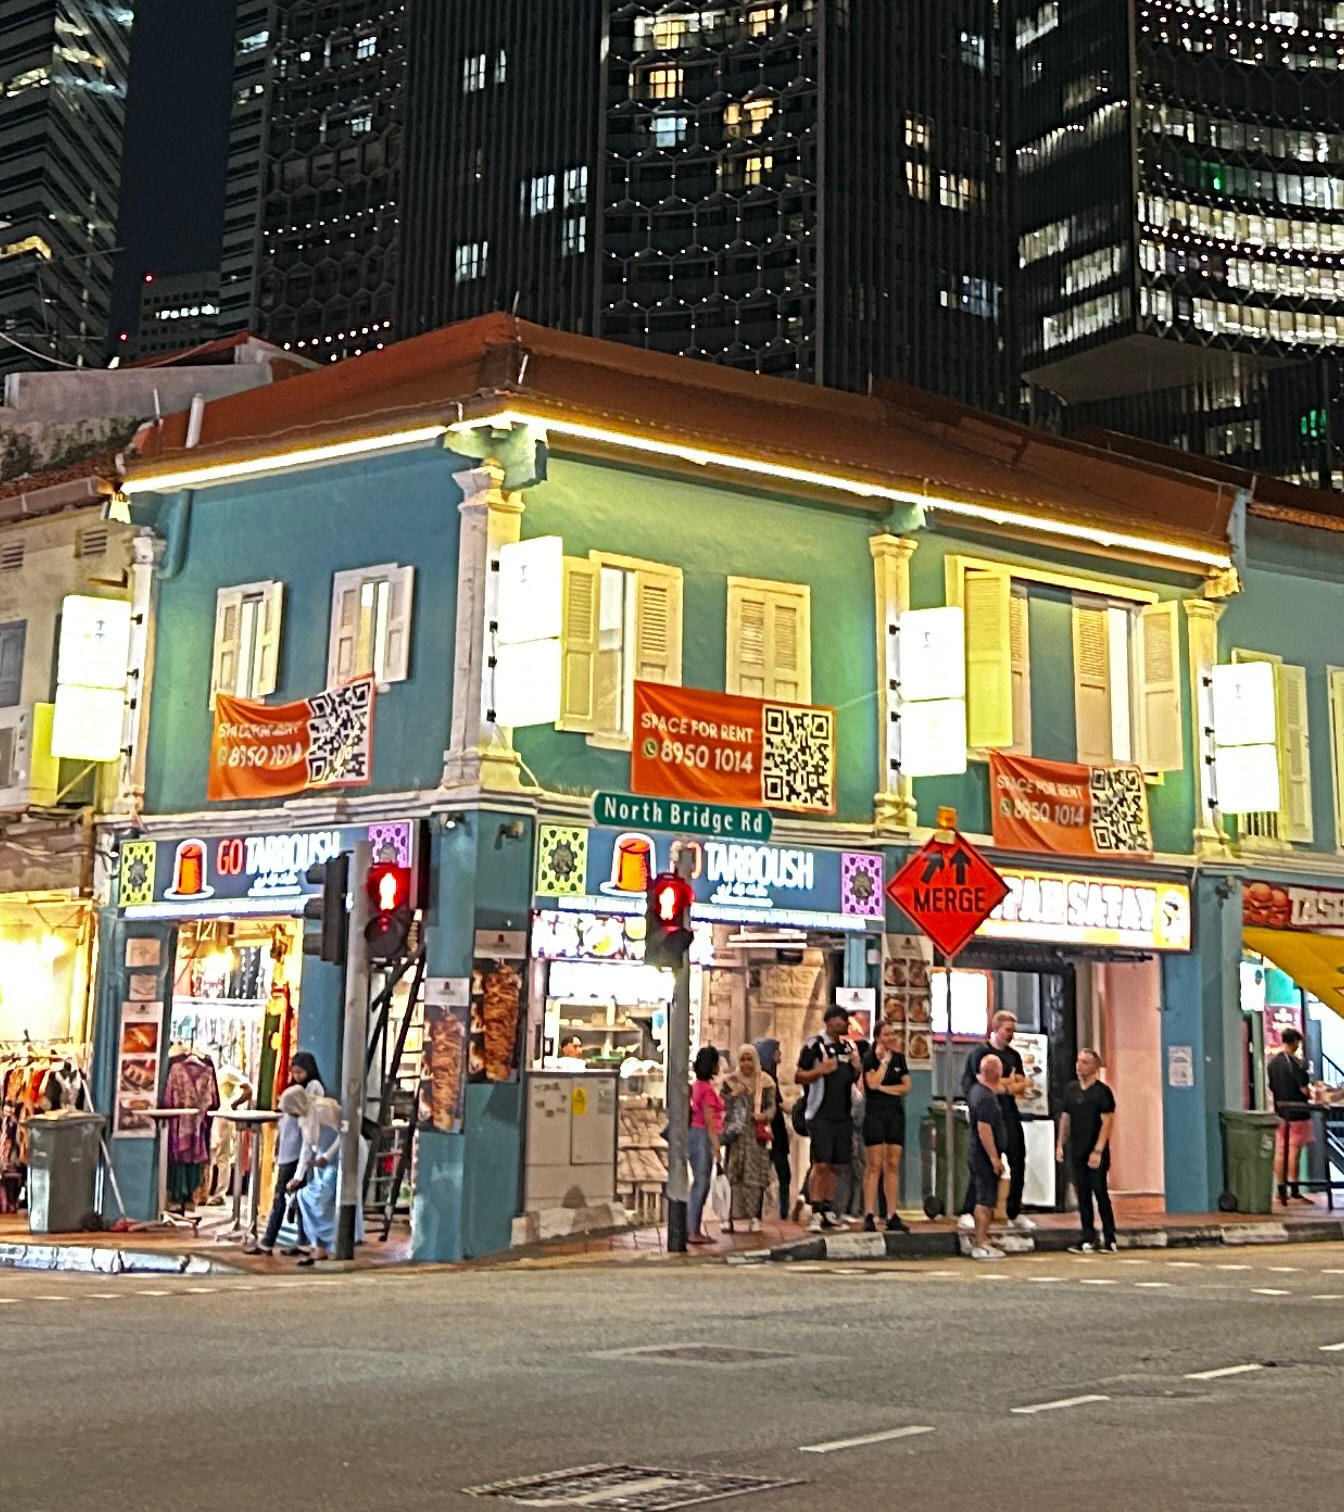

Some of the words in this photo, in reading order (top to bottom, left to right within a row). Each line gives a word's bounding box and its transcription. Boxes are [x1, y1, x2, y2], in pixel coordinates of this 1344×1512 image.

[641, 711, 687, 736] SPACE
[691, 720, 718, 740] FOR
[720, 724, 754, 744] RENT
[660, 739, 709, 769] 8950
[714, 747, 753, 774] 1014
[603, 796, 663, 823] North
[669, 804, 734, 834] Bridge
[741, 811, 764, 834] Rd
[1014, 797, 1051, 823] 8950
[1054, 805, 1085, 826] 1014
[216, 838, 244, 875] GO
[704, 842, 814, 890] TARBOUSH
[913, 887, 987, 913] MERGE
[1067, 879, 1158, 931] SATAY
